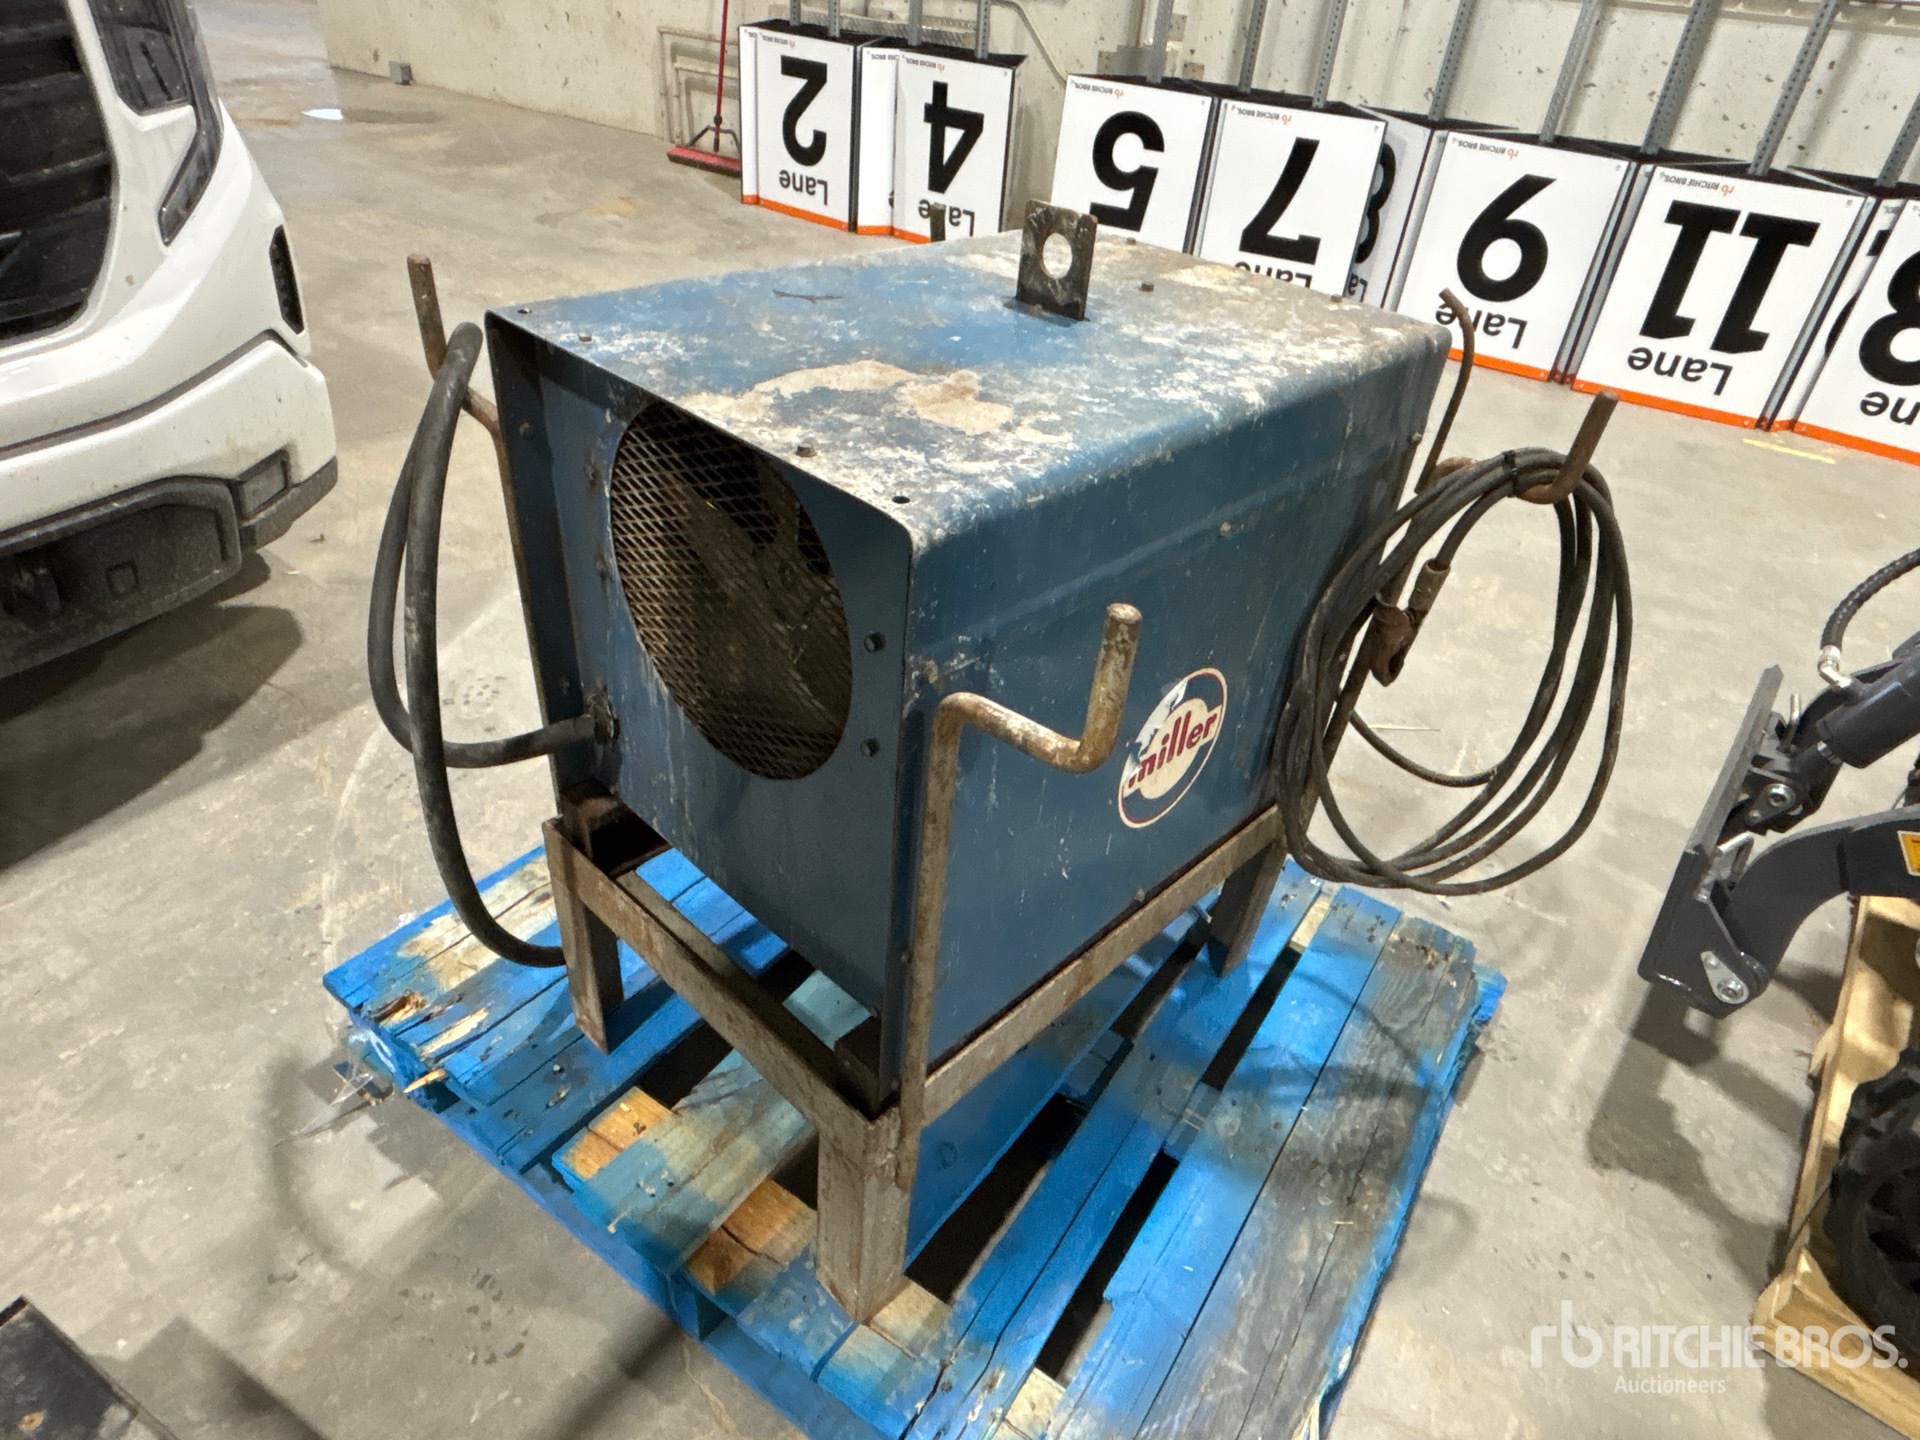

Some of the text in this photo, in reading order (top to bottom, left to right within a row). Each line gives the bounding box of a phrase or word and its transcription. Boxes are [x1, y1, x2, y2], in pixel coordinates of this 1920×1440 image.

[780, 54, 828, 167] 2
[1256, 110, 1280, 121] RITCHIE
[1281, 114, 1292, 126] rb
[923, 80, 985, 195] 4
[1479, 143, 1507, 155] RITCHIE
[1507, 147, 1519, 160] rb
[779, 169, 828, 206] Lane
[1089, 110, 1165, 233] 5
[1687, 178, 1721, 191] RITCHIE
[1239, 136, 1321, 266] 7
[1721, 184, 1735, 197] rb
[918, 198, 976, 237] Lae
[1456, 173, 1557, 303] 9
[1348, 272, 1368, 303] La
[1638, 199, 1821, 355] 11
[1627, 346, 1734, 397] Lane
[1860, 390, 1920, 426] ne
